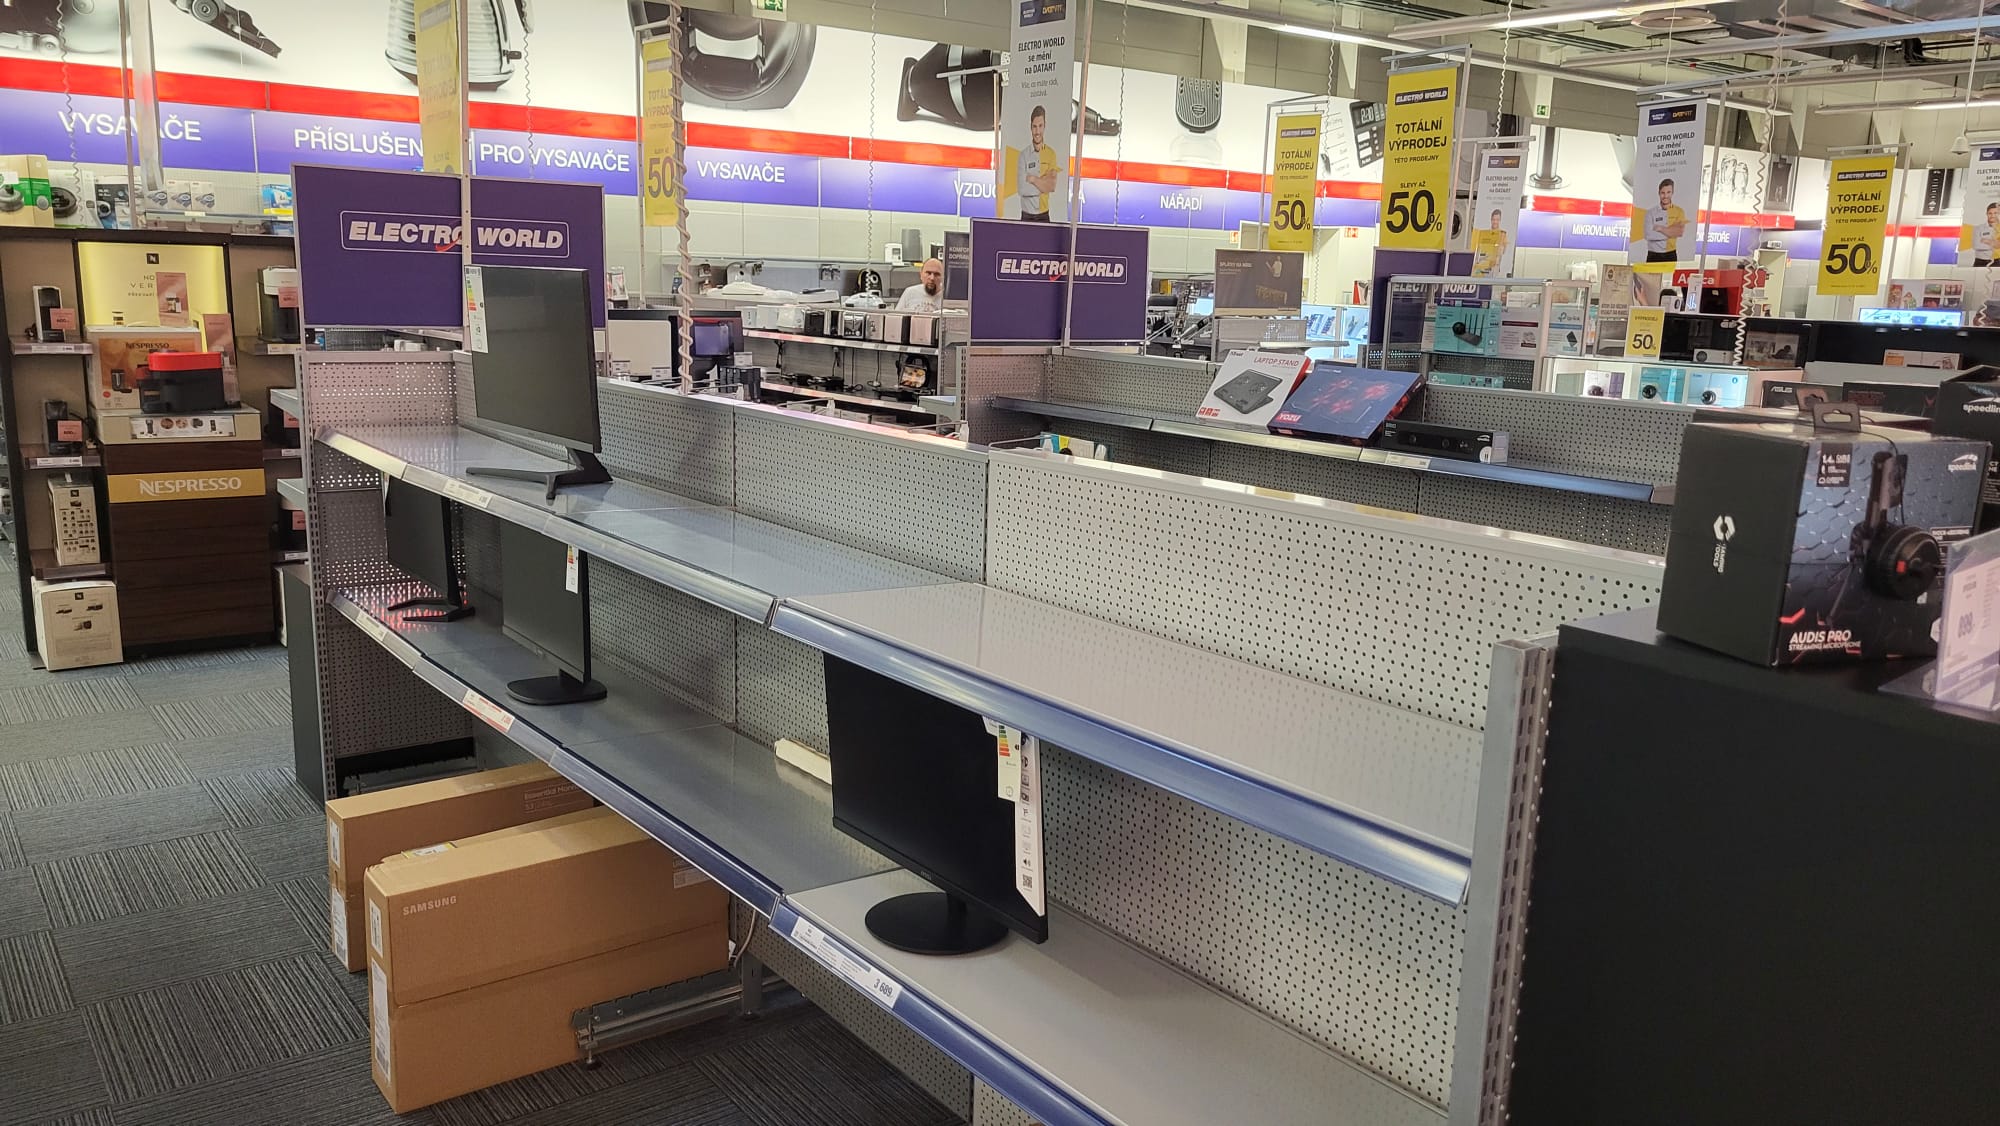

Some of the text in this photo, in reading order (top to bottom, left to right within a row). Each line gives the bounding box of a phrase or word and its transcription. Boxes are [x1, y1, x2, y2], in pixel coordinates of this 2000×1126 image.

[1018, 36, 1065, 52] ELECTRO WORLD
[1024, 62, 1057, 75] na DATART
[1395, 90, 1448, 104] ELECTRO WORLD
[58, 111, 202, 141] VYSAČE
[1395, 116, 1443, 135] TOTÁLNÍ
[1388, 135, 1447, 152] VÝPRODEJ
[1646, 131, 1695, 143] ELECTRO WORLD
[480, 143, 524, 165] PRO
[530, 147, 630, 173] VYSAVAČE
[1281, 148, 1312, 160] TOTÁLNÍ
[1394, 154, 1439, 164] TÉTO PRODEJNY
[1661, 148, 1686, 158] DATART
[697, 160, 785, 183] VYSAVAČE
[1276, 161, 1315, 171] VÝPRODEJ
[1400, 180, 1426, 189] SLEVY AŽ
[1160, 193, 1203, 211] NÁŘADÍ
[1837, 190, 1882, 203] TOTÁLNÍ
[1273, 199, 1311, 231] 50%
[1385, 189, 1443, 234] 50%
[1830, 203, 1885, 215] VÝPRODEJ
[349, 220, 564, 249] ELECTRO WORLD
[1572, 223, 1618, 237] MIKROVLNNÉ
[1825, 243, 1878, 275] 50%
[1000, 258, 1125, 278] ELECTRO WORLD
[126, 342, 170, 350] NESPRESSO
[1253, 357, 1299, 367] LAPTOP STAND
[136, 476, 242, 497] NESPRESSO
[1789, 629, 1852, 644] AUDIS PRO
[1788, 640, 1862, 651] STREAMING MICROPHONE
[402, 895, 457, 916] SAMSUNG
[873, 978, 893, 997] 3 689
